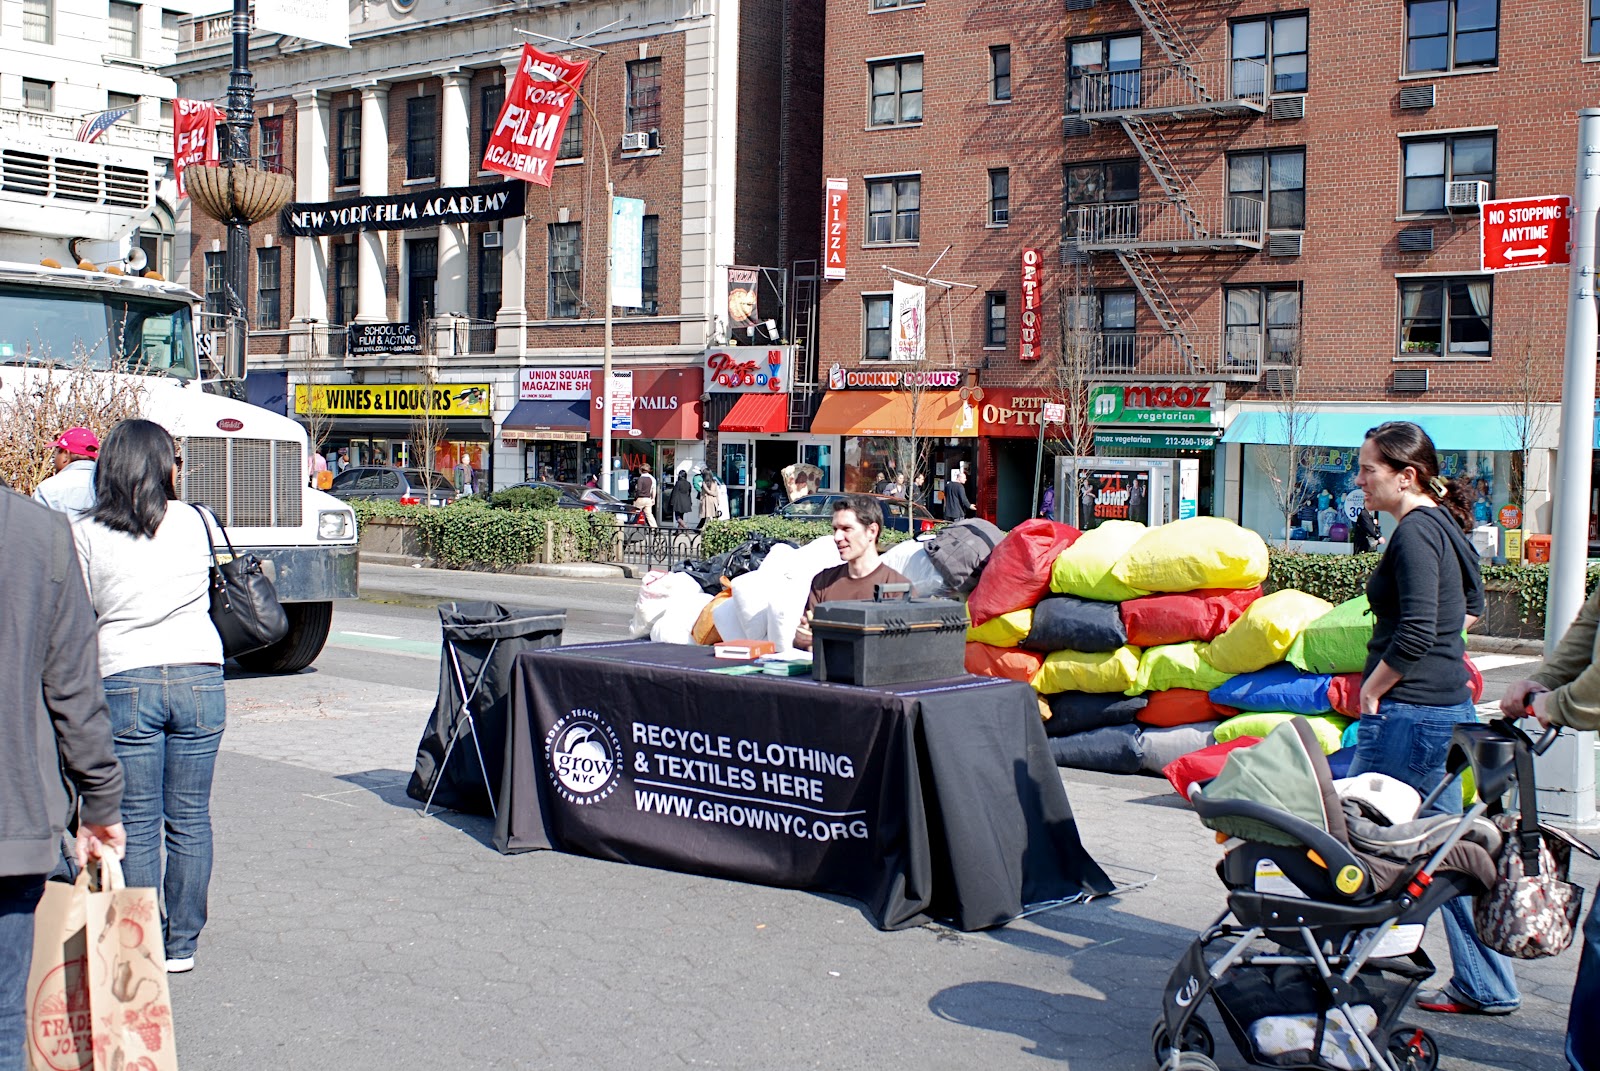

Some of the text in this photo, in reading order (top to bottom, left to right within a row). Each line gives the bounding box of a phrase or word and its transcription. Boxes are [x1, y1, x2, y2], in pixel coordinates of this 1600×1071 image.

[526, 85, 570, 108] YORK
[495, 103, 560, 150] FILM
[177, 126, 206, 154] FIL
[485, 144, 548, 176] ACADEMY
[292, 190, 510, 228] NEW YORK FILM ACADEMY
[1489, 206, 1562, 224] NO STOPPING
[830, 194, 842, 263] PIZZA
[1502, 226, 1548, 242] ANYTIME
[728, 270, 758, 283] PIZZA
[1022, 250, 1038, 357] OPTIQUE
[359, 335, 416, 346] FILM & ACTING
[364, 325, 410, 336] SCHOOL OF
[530, 370, 556, 380] UNION
[719, 375, 765, 385] BASH
[768, 350, 781, 392] NYC
[848, 372, 958, 386] DUNKIN' DONUTS
[522, 382, 572, 390] MAGAZINE
[326, 390, 372, 410] WINES
[374, 394, 383, 410] &
[386, 390, 450, 410] LIQUORS
[639, 396, 678, 410] NAILS
[1124, 386, 1211, 408] maoz
[1137, 412, 1195, 422] vegetarian
[1115, 436, 1151, 444] vegetarian
[1094, 490, 1128, 506] JUMP
[1094, 505, 1128, 518] STREET
[572, 709, 599, 720] TEACH
[544, 718, 566, 760] GARDEN
[606, 726, 624, 770] RECYCLE
[632, 722, 854, 778] RECYCLE CLOTHING
[558, 756, 614, 776] grow
[572, 773, 595, 784] NYC
[634, 752, 824, 802] & TEXTILES HERE
[550, 772, 618, 804] GREENMARKET
[634, 790, 868, 842] WWW.GROWNYC.ORG
[40, 1014, 92, 1038] TRADE
